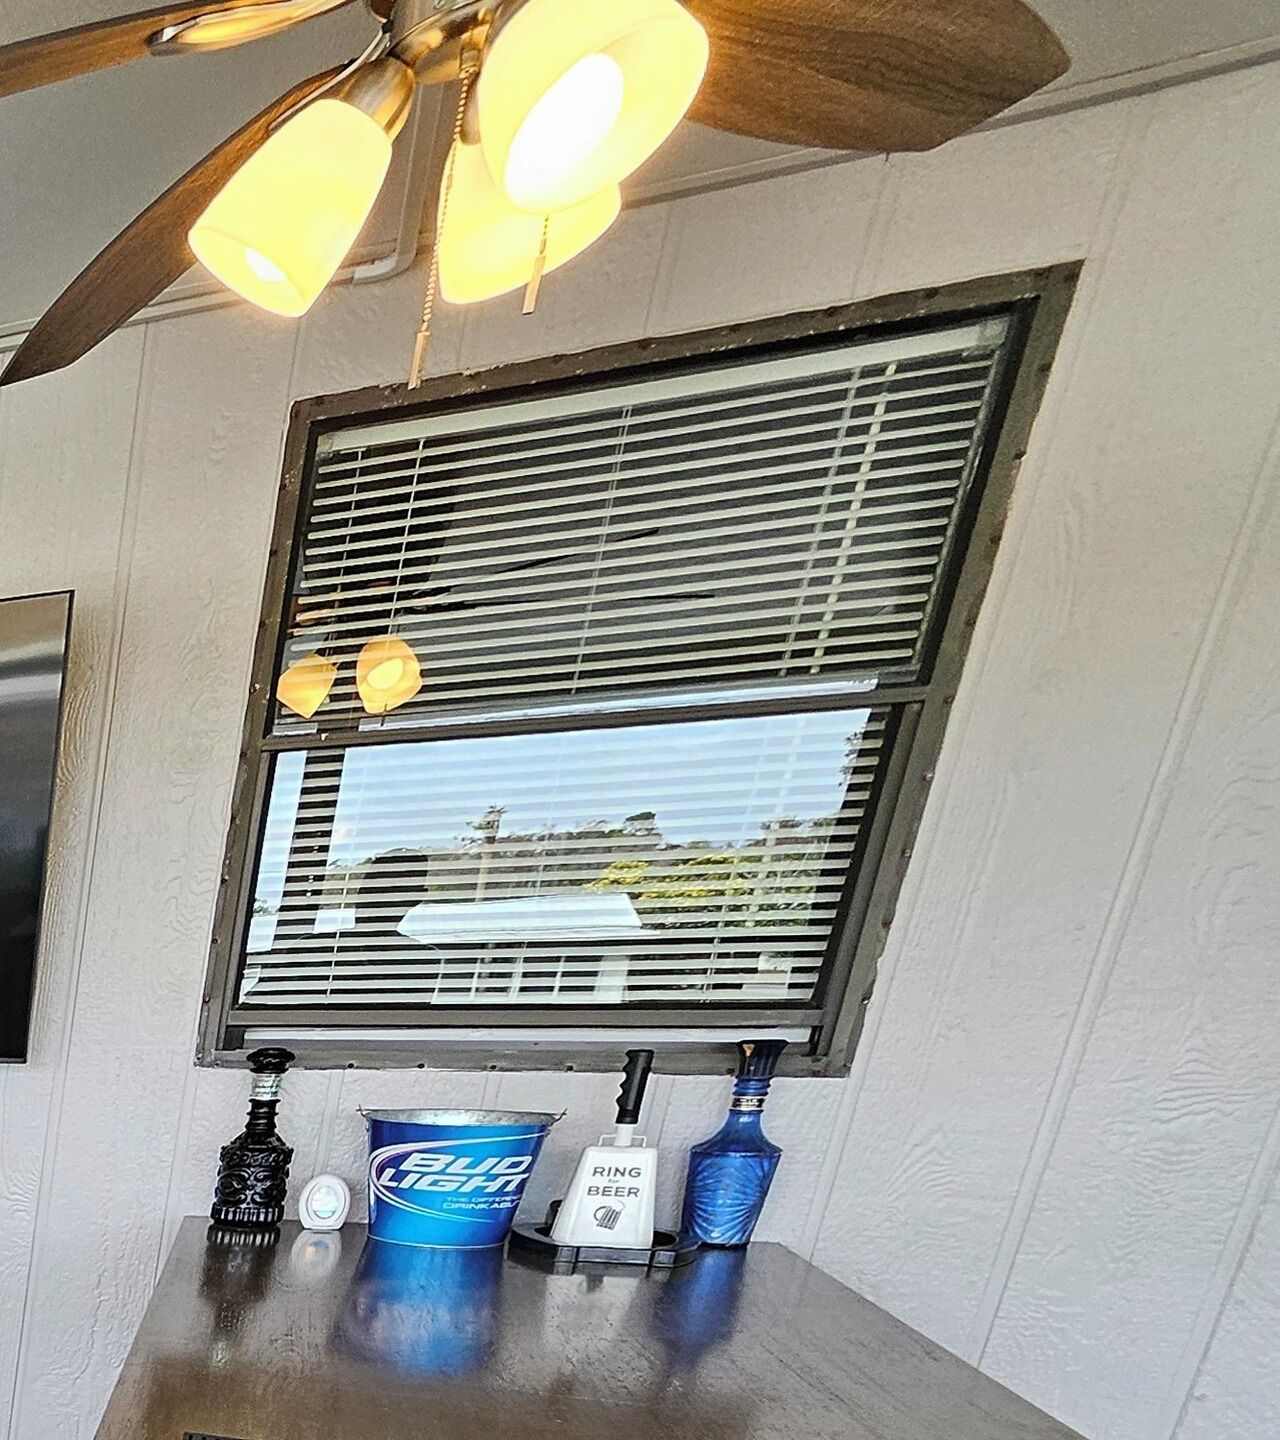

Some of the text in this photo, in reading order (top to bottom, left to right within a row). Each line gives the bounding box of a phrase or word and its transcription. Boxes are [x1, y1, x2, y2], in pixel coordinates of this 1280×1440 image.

[399, 1152, 533, 1174] BUD
[378, 1168, 530, 1193] LIGHT
[592, 1166, 642, 1178] RING
[587, 1185, 640, 1198] BEER
